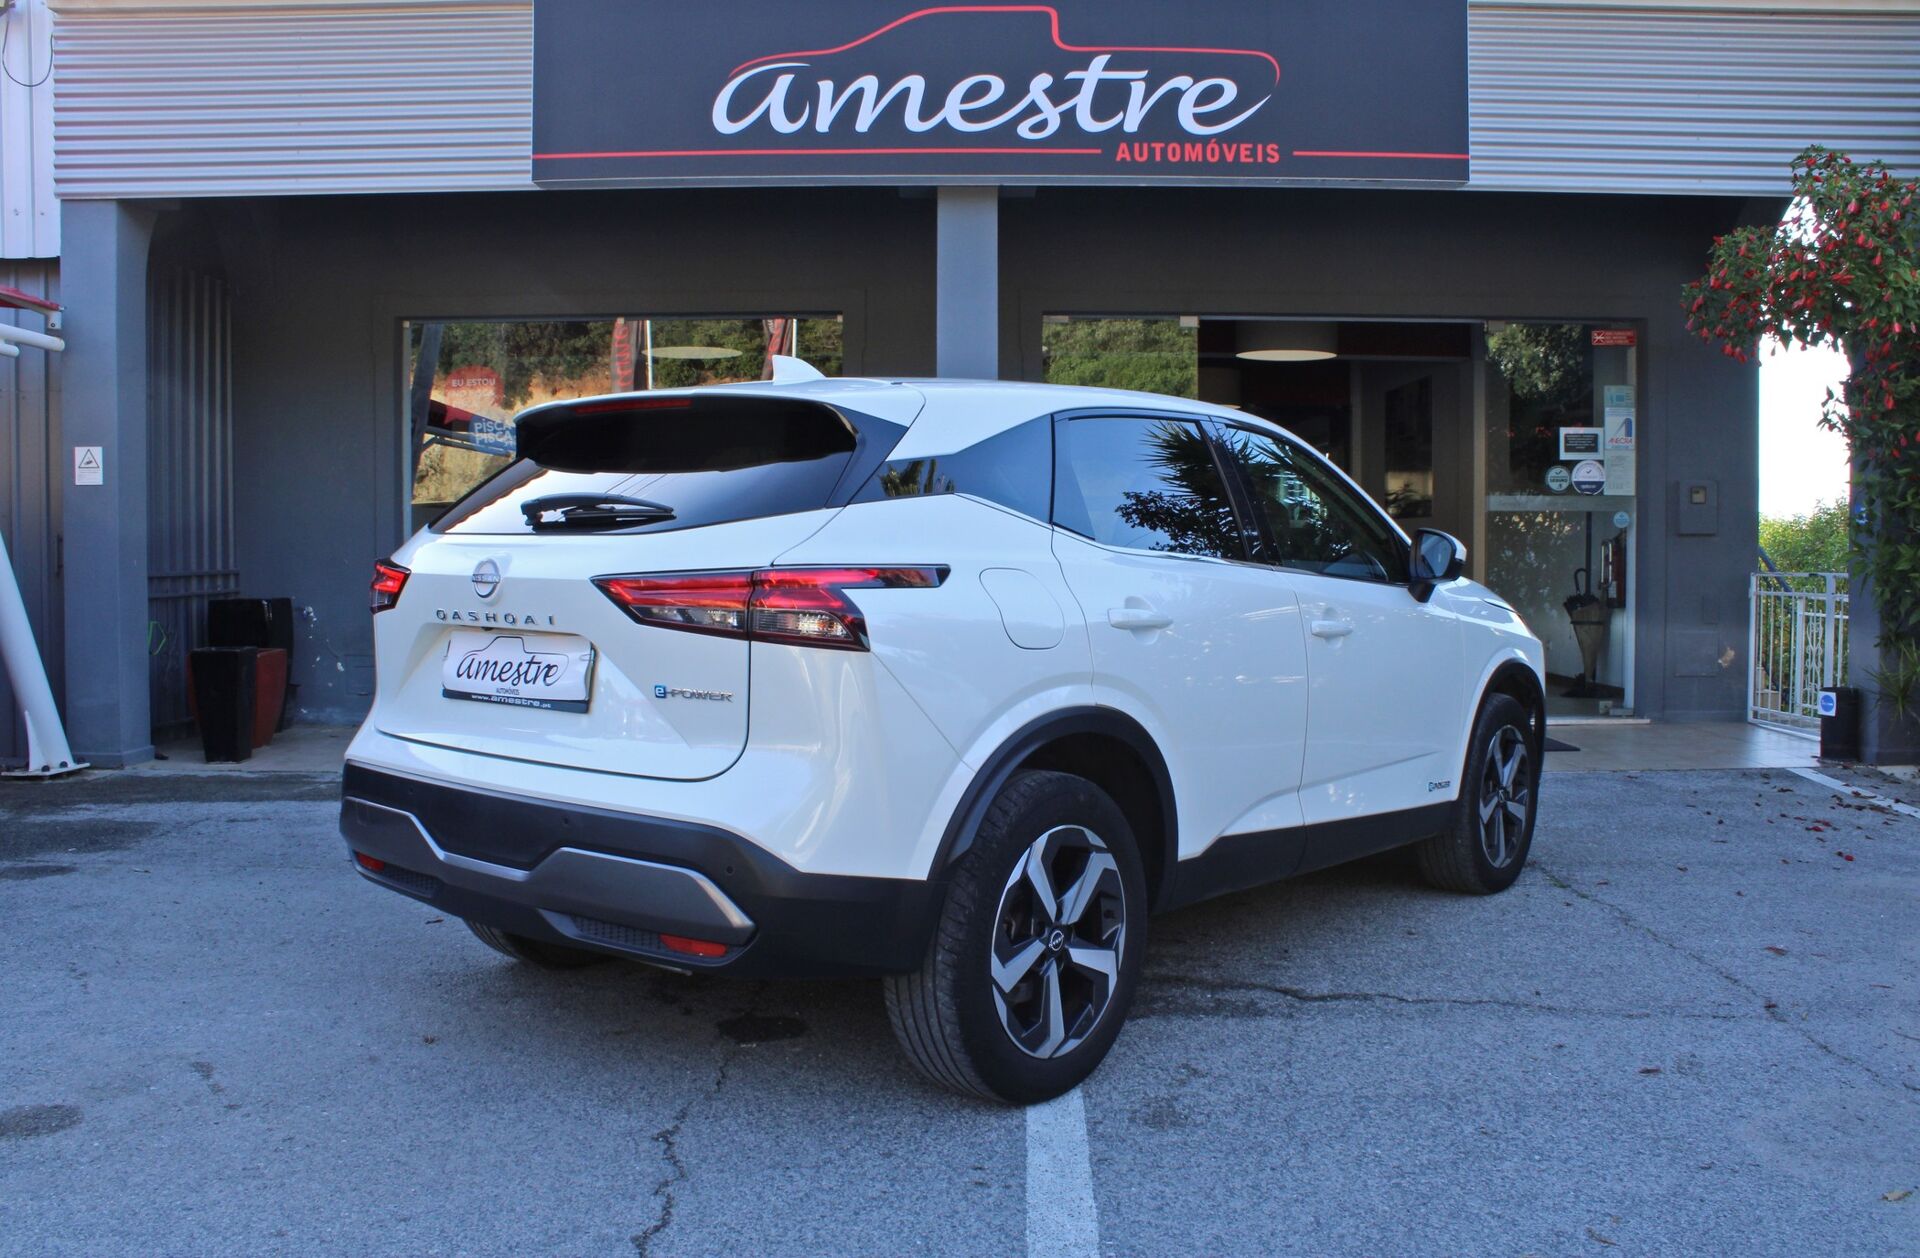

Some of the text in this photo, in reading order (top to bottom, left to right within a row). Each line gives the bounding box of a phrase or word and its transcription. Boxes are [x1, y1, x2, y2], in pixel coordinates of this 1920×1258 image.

[712, 54, 1272, 139] amestre
[1115, 138, 1281, 164] AUTOMÓVEIS
[452, 377, 496, 387] EU ESTOU
[472, 574, 500, 583] NISSAN
[436, 609, 556, 625] QASHQAI
[456, 655, 563, 687] amestre
[471, 694, 552, 709] www.amestre.pt
